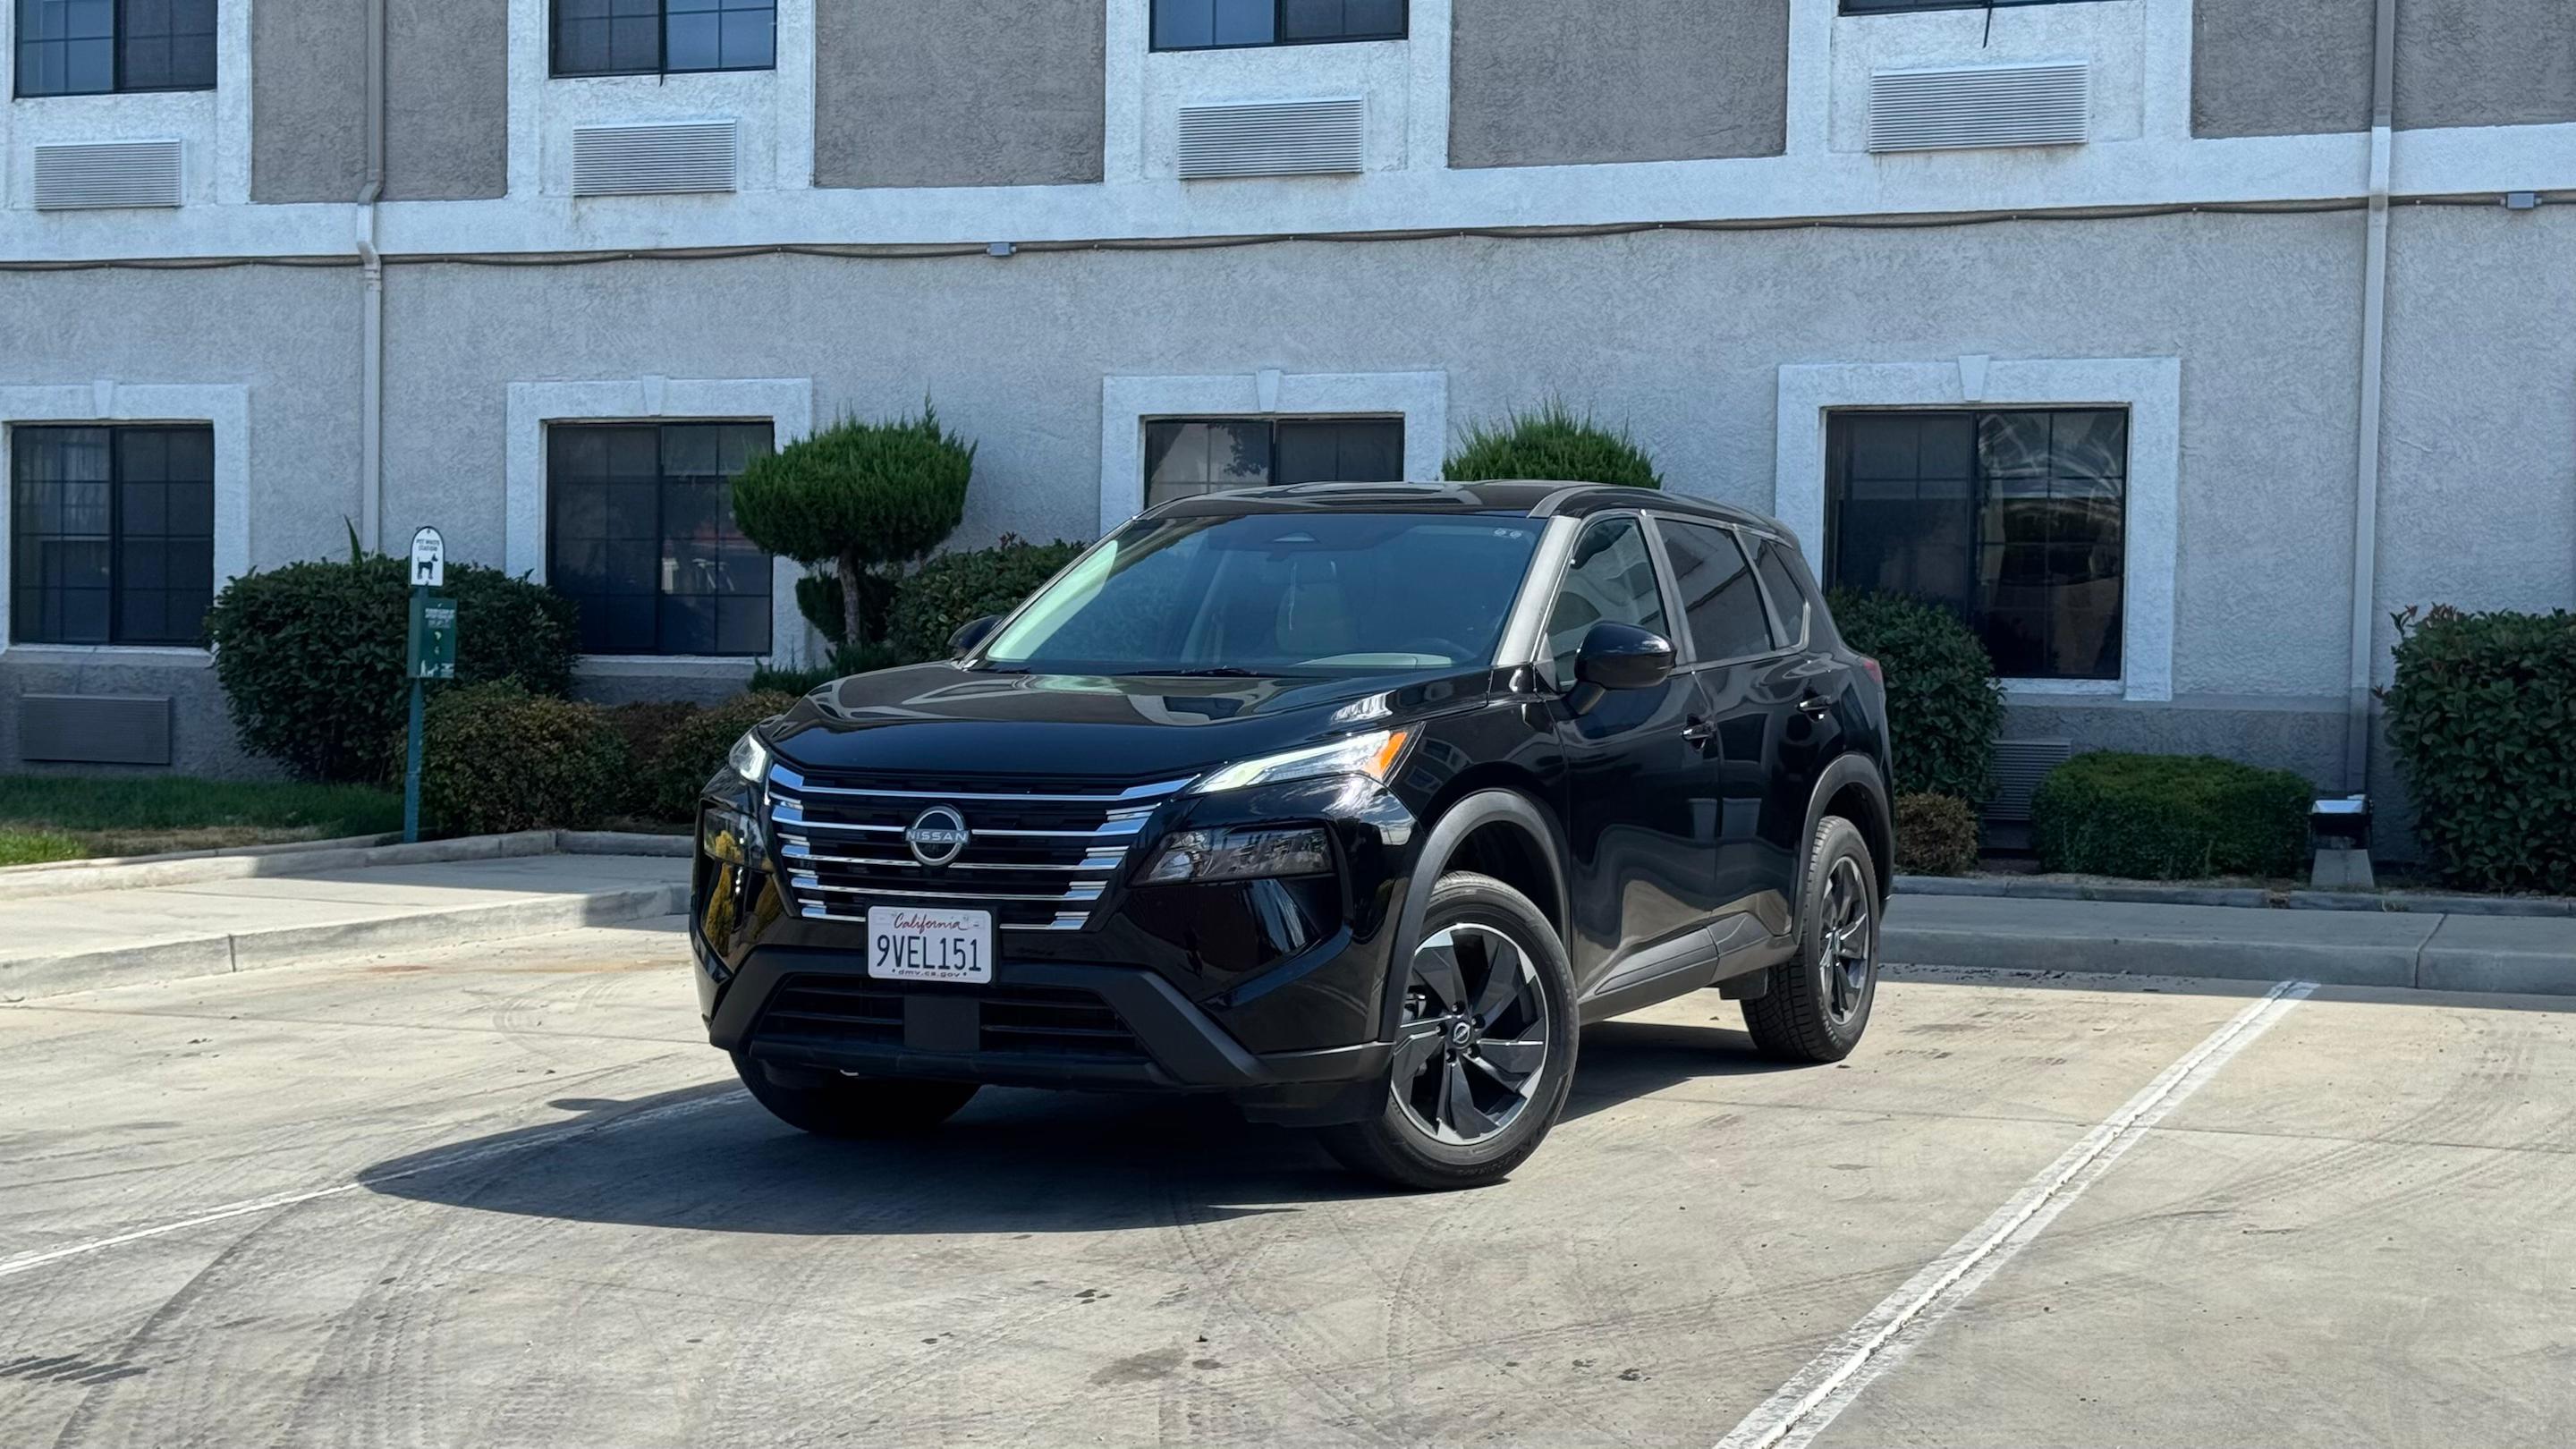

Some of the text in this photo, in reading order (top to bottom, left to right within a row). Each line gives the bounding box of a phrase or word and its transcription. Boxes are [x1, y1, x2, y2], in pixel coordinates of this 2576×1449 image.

[906, 830, 968, 841] NISSAN
[894, 912, 969, 934] California
[877, 934, 982, 972] 9VEL151
[898, 969, 961, 978] dmv.ca.gov
